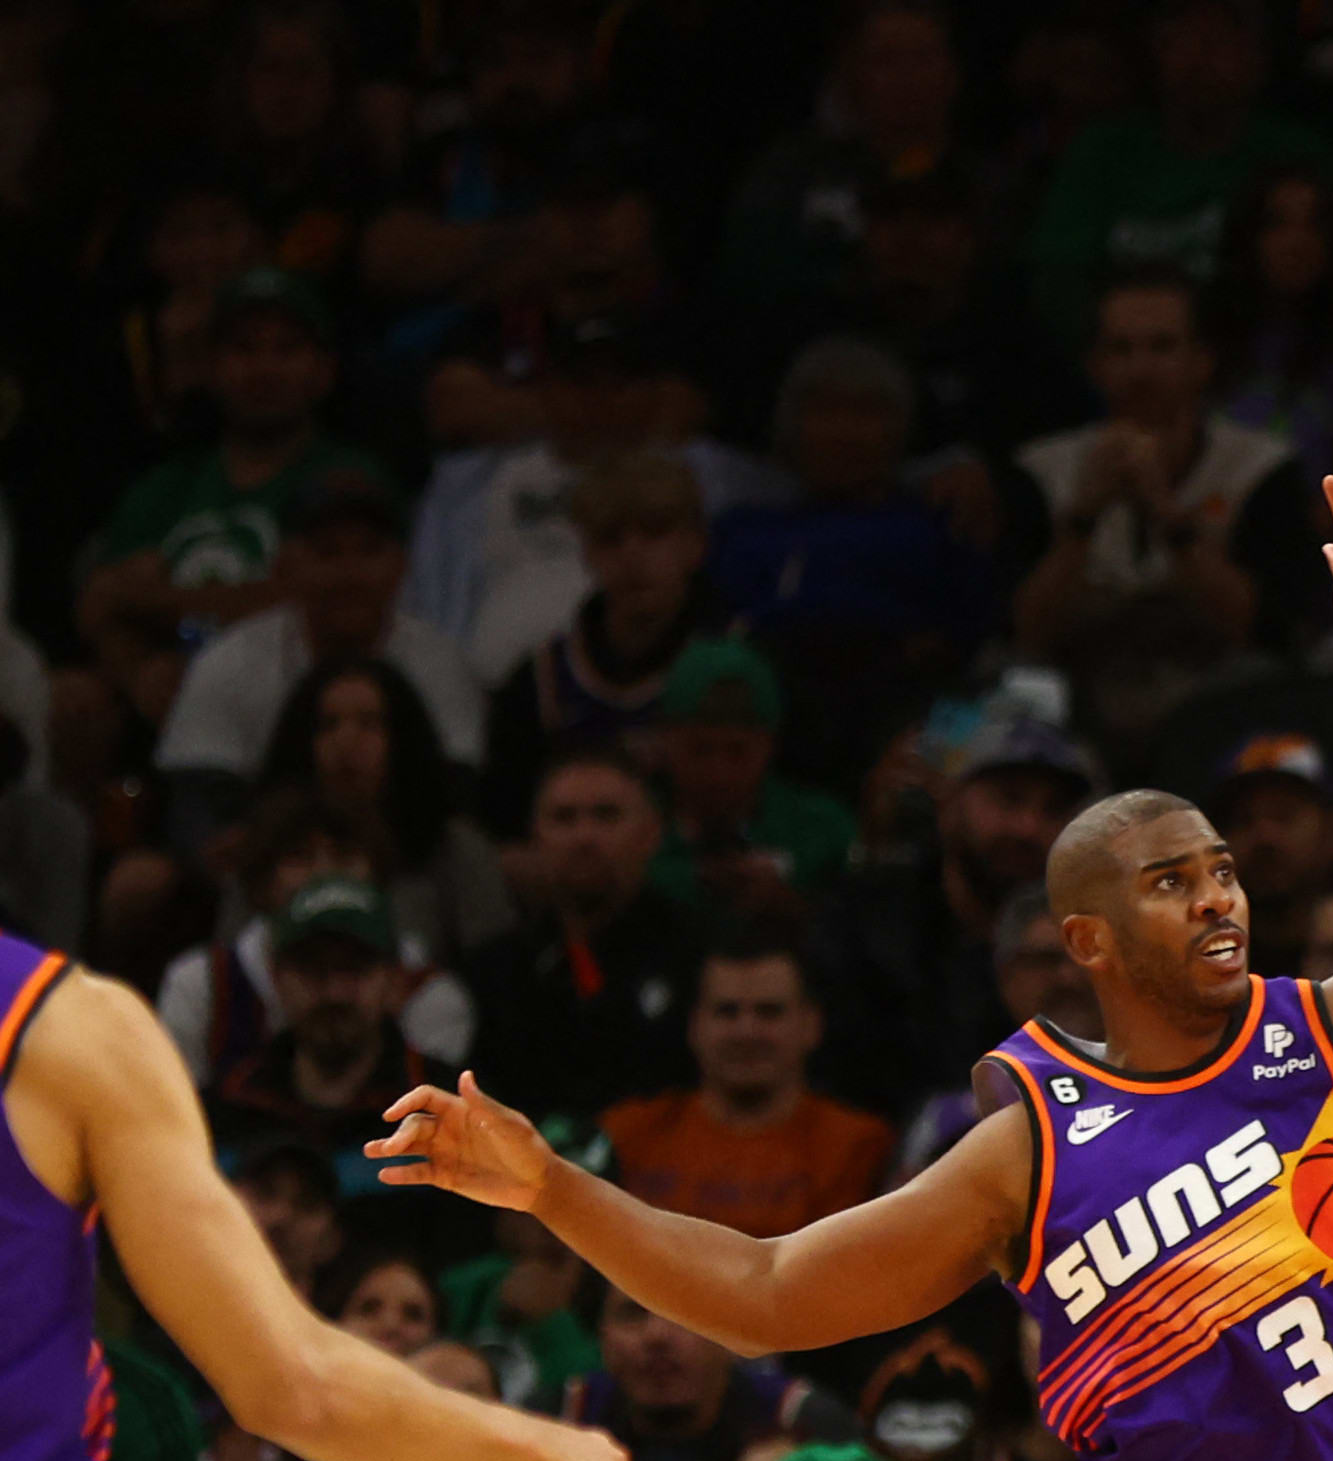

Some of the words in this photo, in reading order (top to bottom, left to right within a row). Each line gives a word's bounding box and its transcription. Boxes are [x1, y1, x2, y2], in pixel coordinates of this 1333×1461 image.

[1252, 1052, 1316, 1081] PayPal
[1050, 1076, 1080, 1104] 6
[1075, 1104, 1116, 1130] NIKE
[1044, 1119, 1284, 1325] SUNS
